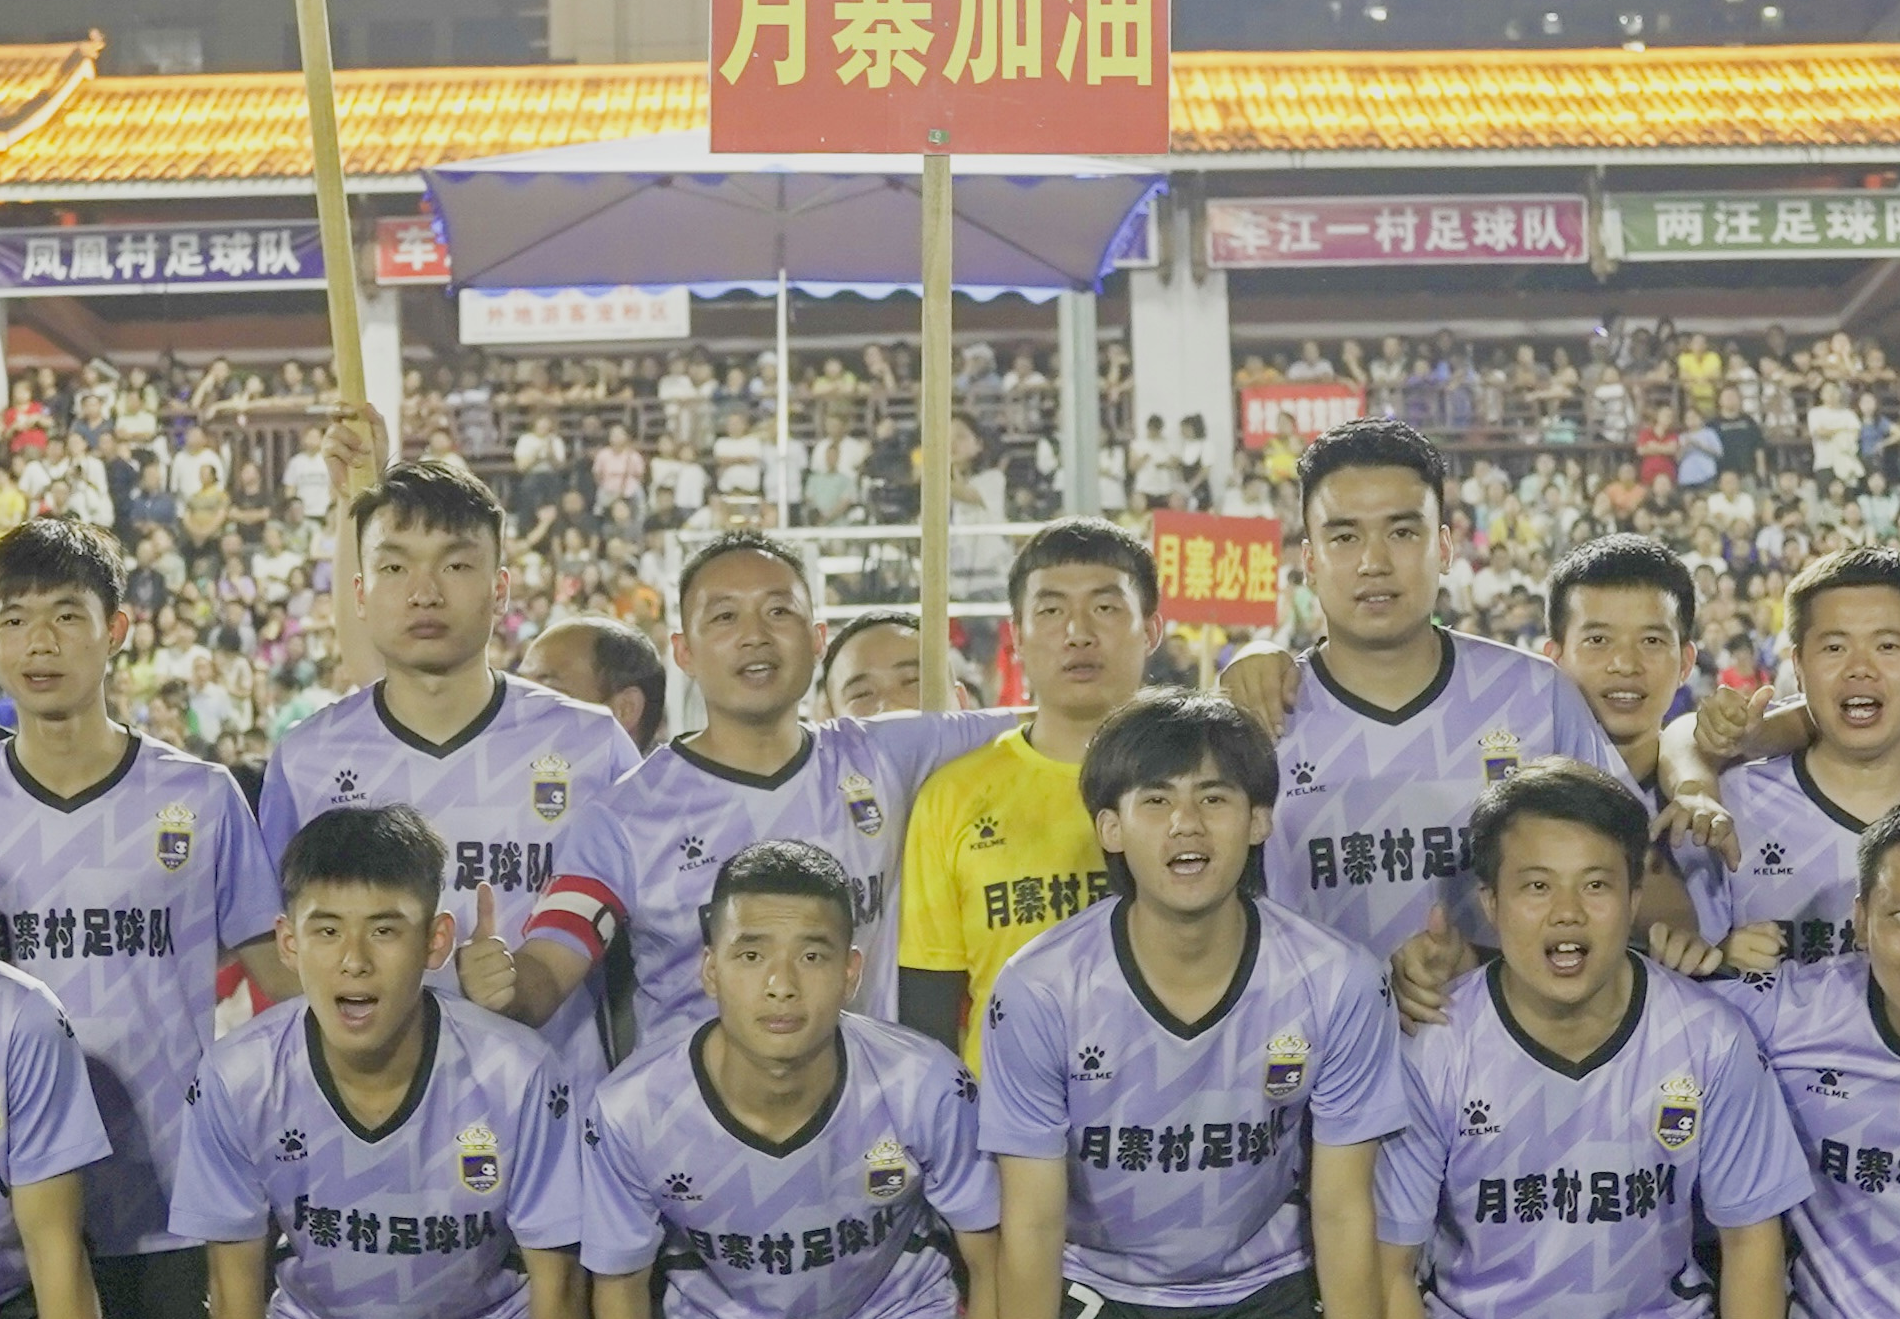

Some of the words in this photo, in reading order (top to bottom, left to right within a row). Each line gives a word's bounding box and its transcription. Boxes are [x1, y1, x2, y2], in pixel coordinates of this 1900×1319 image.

[1229, 206, 1567, 254] 车江一村足球队
[392, 228, 451, 270] 车
[22, 233, 301, 280] 凤凰村足球队
[1158, 535, 1278, 601] 月寨必胜
[1286, 785, 1326, 797] KELME
[331, 792, 367, 803] KELME
[969, 838, 1007, 849] KELME
[454, 841, 553, 892] 足球队
[679, 856, 717, 871] KELME
[1753, 866, 1794, 876] KELME
[1071, 1071, 1113, 1081] KELME
[1806, 1085, 1849, 1099] KELME
[1459, 1126, 1501, 1136] KELME
[274, 1151, 308, 1162] KELM
[662, 1193, 702, 1202] KELME
